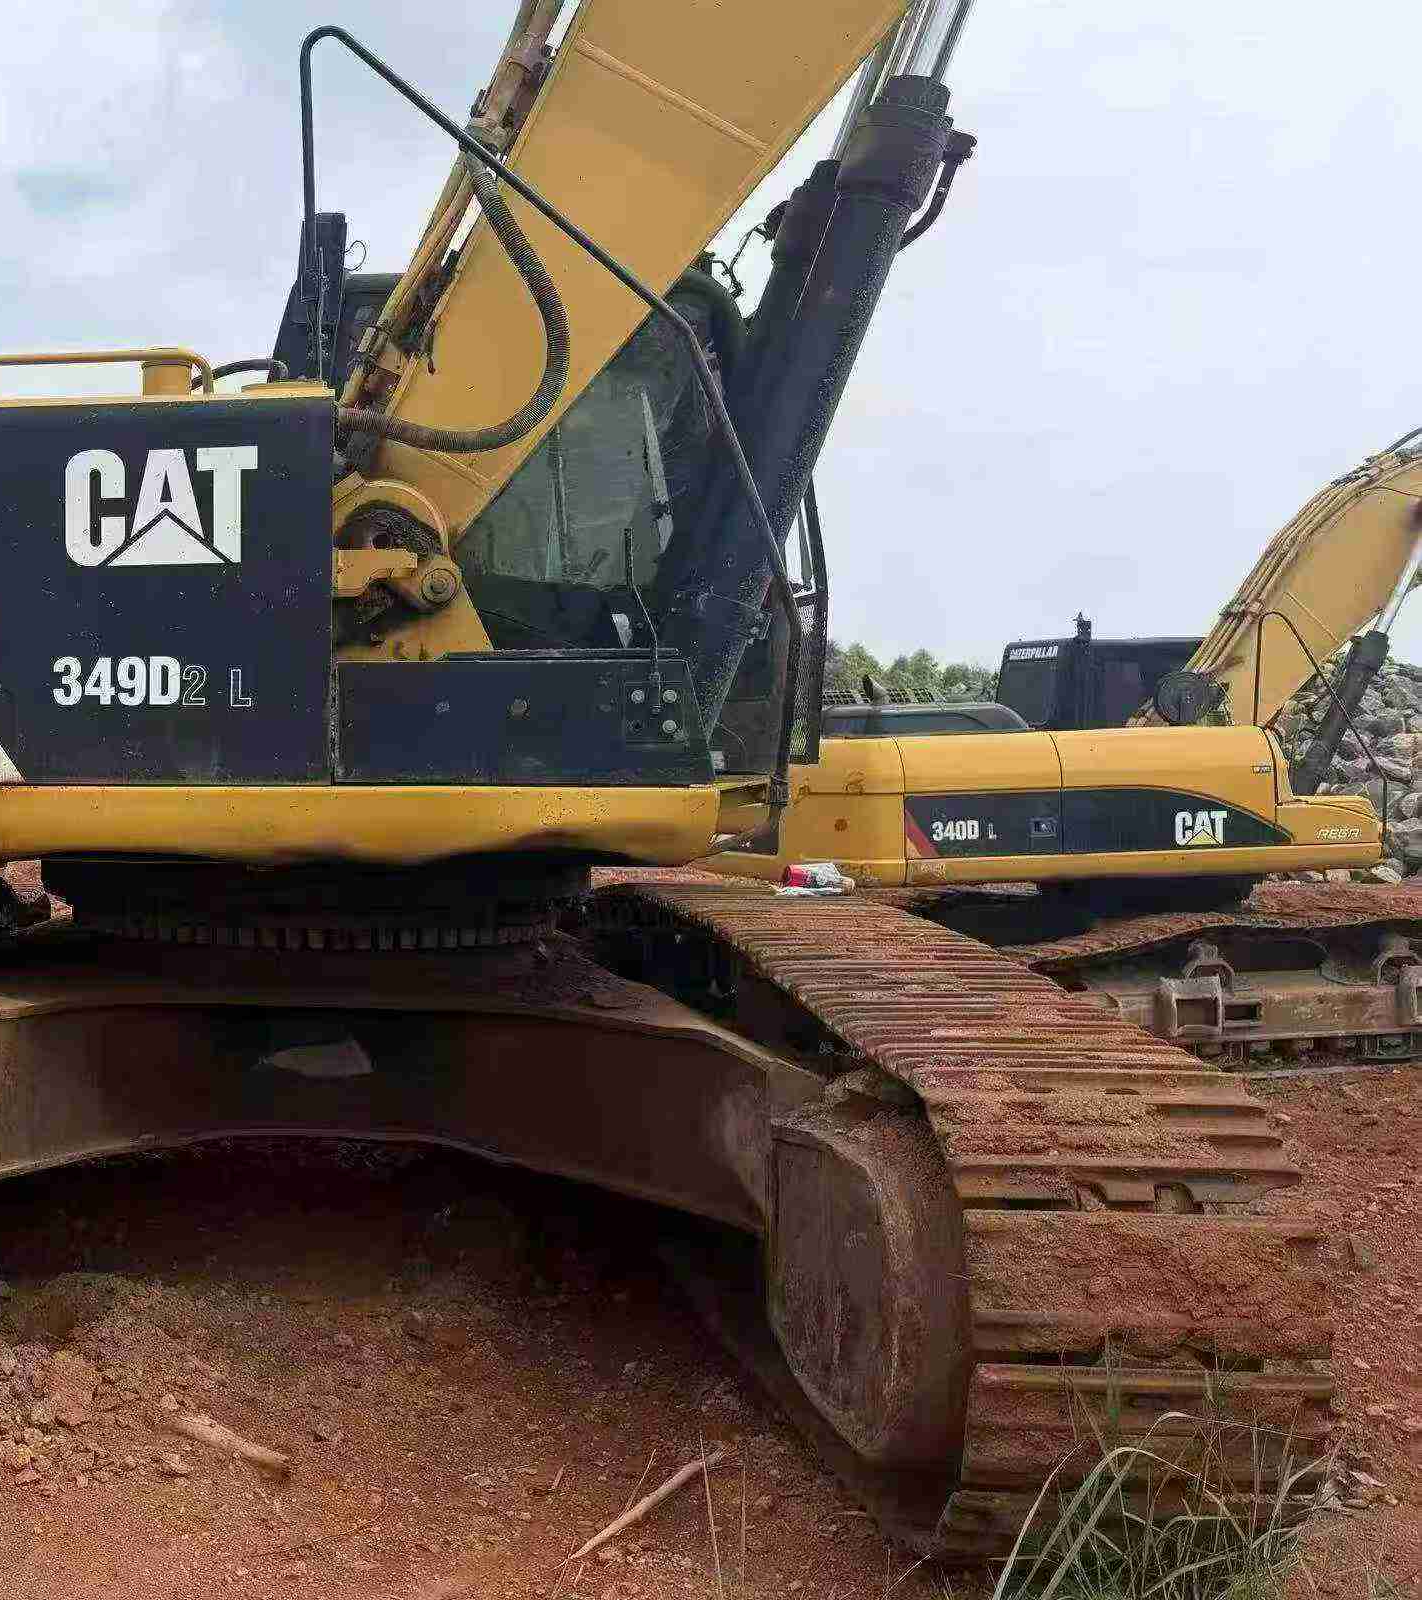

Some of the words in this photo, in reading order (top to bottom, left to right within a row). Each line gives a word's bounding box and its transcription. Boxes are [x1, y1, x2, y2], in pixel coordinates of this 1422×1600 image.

[65, 446, 258, 567] CAT
[230, 668, 252, 707] L
[932, 820, 979, 841] 340D
[1175, 811, 1227, 846] CAT
